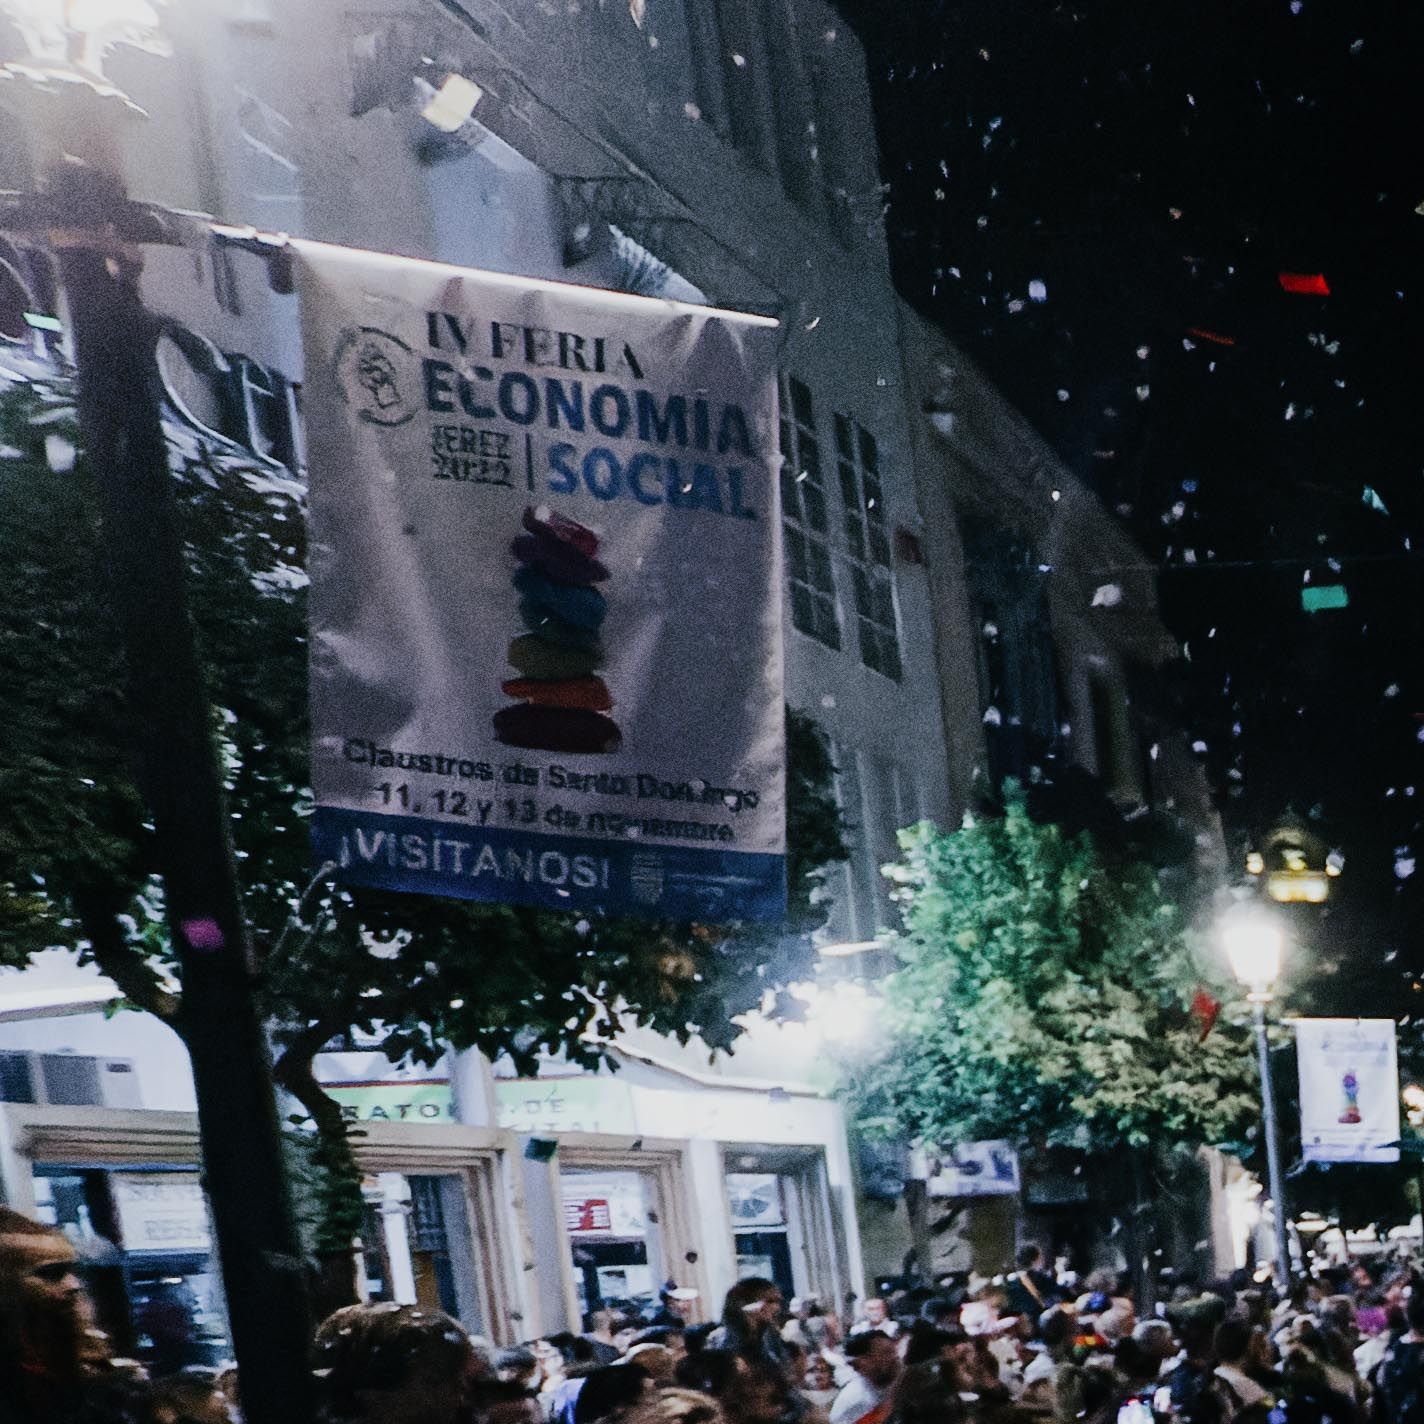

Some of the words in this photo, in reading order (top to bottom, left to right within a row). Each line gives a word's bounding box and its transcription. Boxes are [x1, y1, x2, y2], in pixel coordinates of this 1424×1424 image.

[427, 311, 473, 355] IV
[491, 321, 645, 380] FERIA
[431, 424, 511, 459] JEREZ
[547, 440, 758, 520] SOCIAL
[345, 738, 494, 781] Claustros
[503, 762, 540, 786] de
[433, 788, 467, 816] 12
[476, 799, 493, 826] y
[503, 798, 538, 824] 13
[544, 803, 582, 828] de
